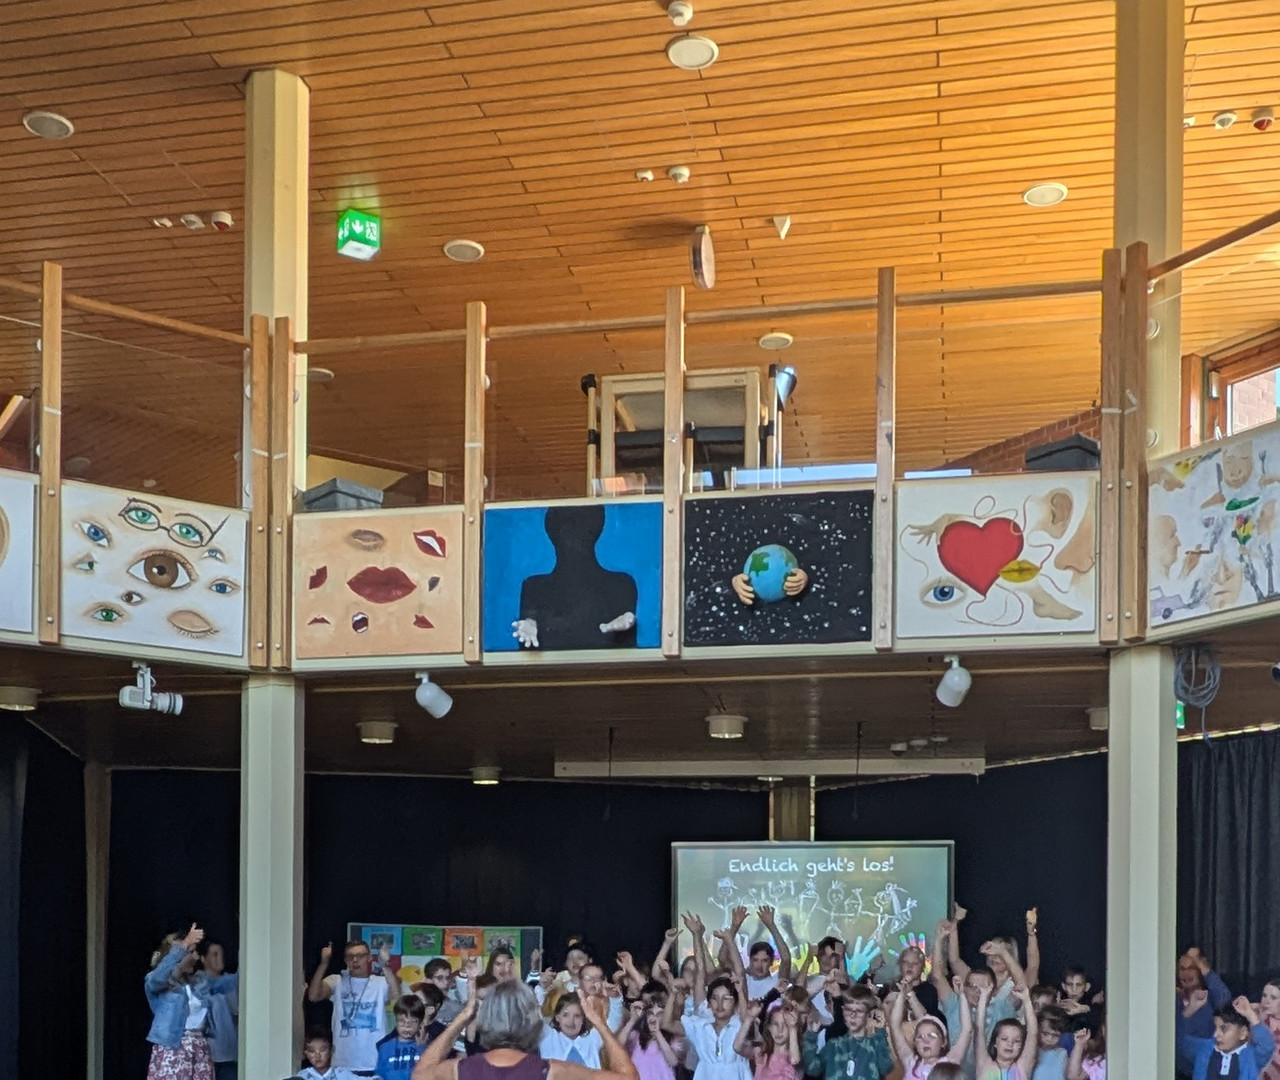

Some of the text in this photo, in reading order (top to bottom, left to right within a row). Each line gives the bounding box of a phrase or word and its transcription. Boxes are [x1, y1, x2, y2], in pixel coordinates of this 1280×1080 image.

[729, 856, 894, 878] Endlich geht's los!
